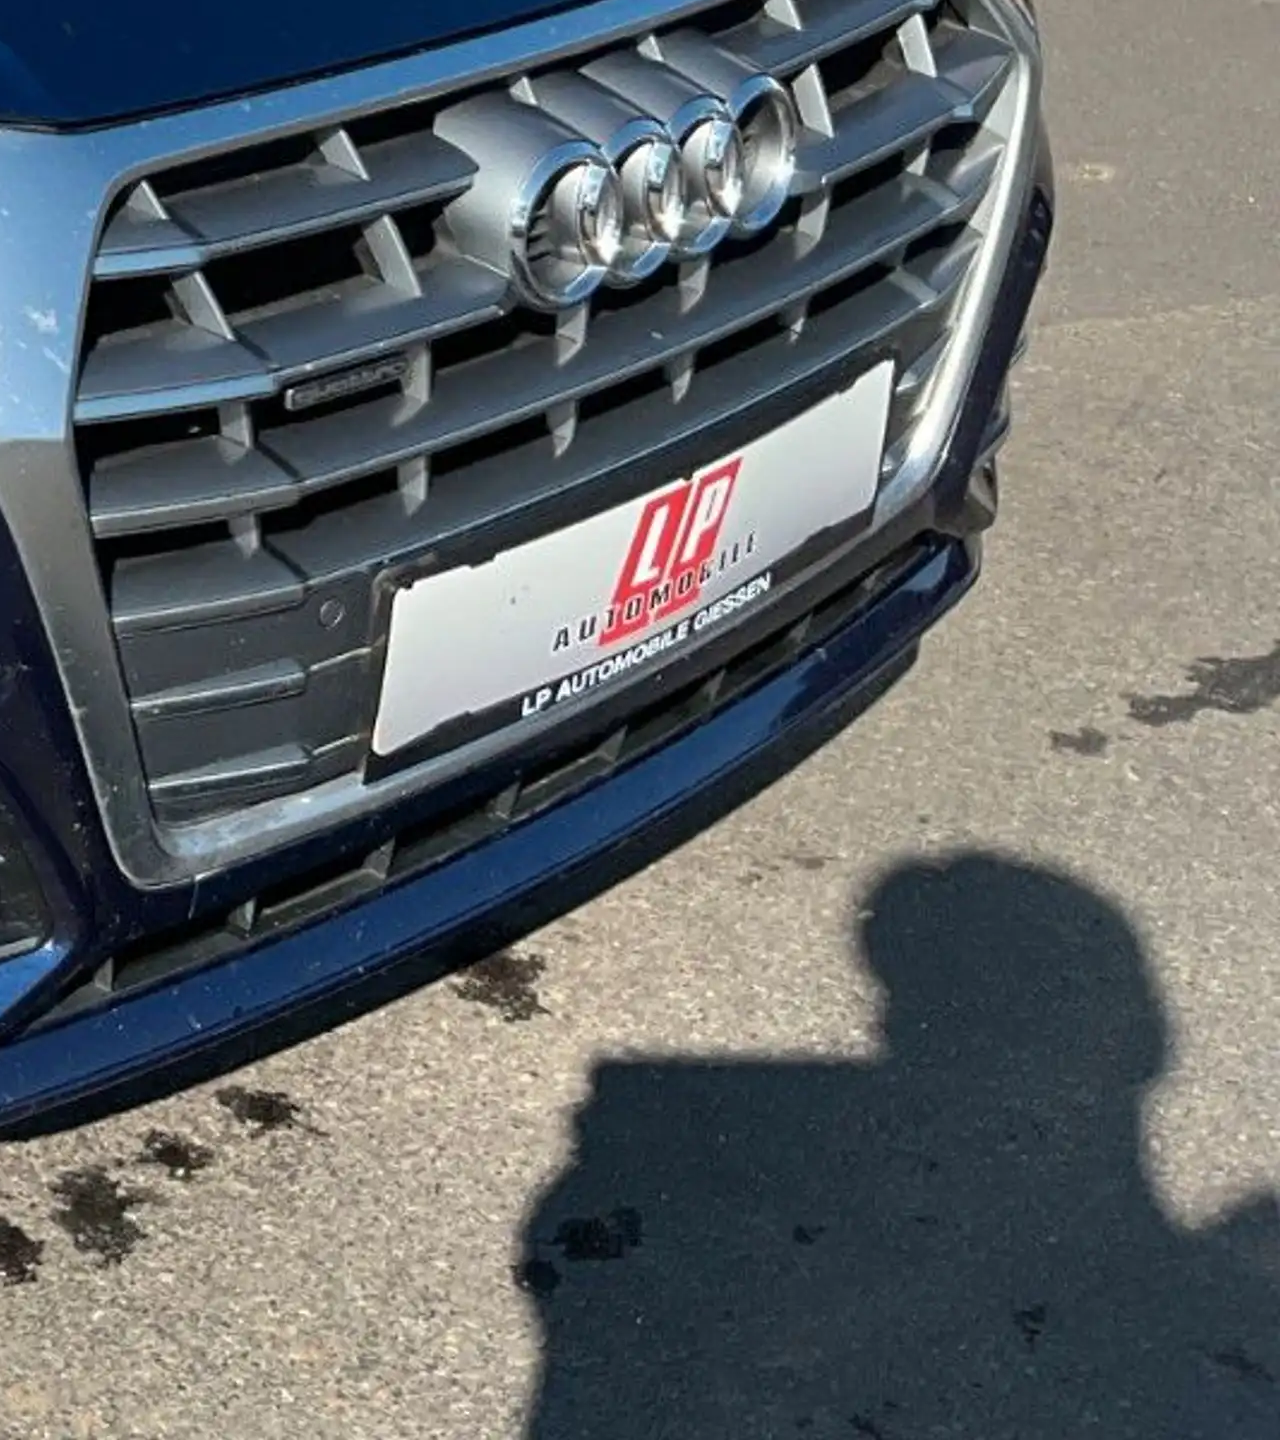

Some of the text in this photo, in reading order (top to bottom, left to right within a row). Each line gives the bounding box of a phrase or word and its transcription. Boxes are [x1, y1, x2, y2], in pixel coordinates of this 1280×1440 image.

[520, 571, 773, 717] LP AUTOMOBILE GIESSEN
[552, 530, 757, 652] AUTOMOBILE
